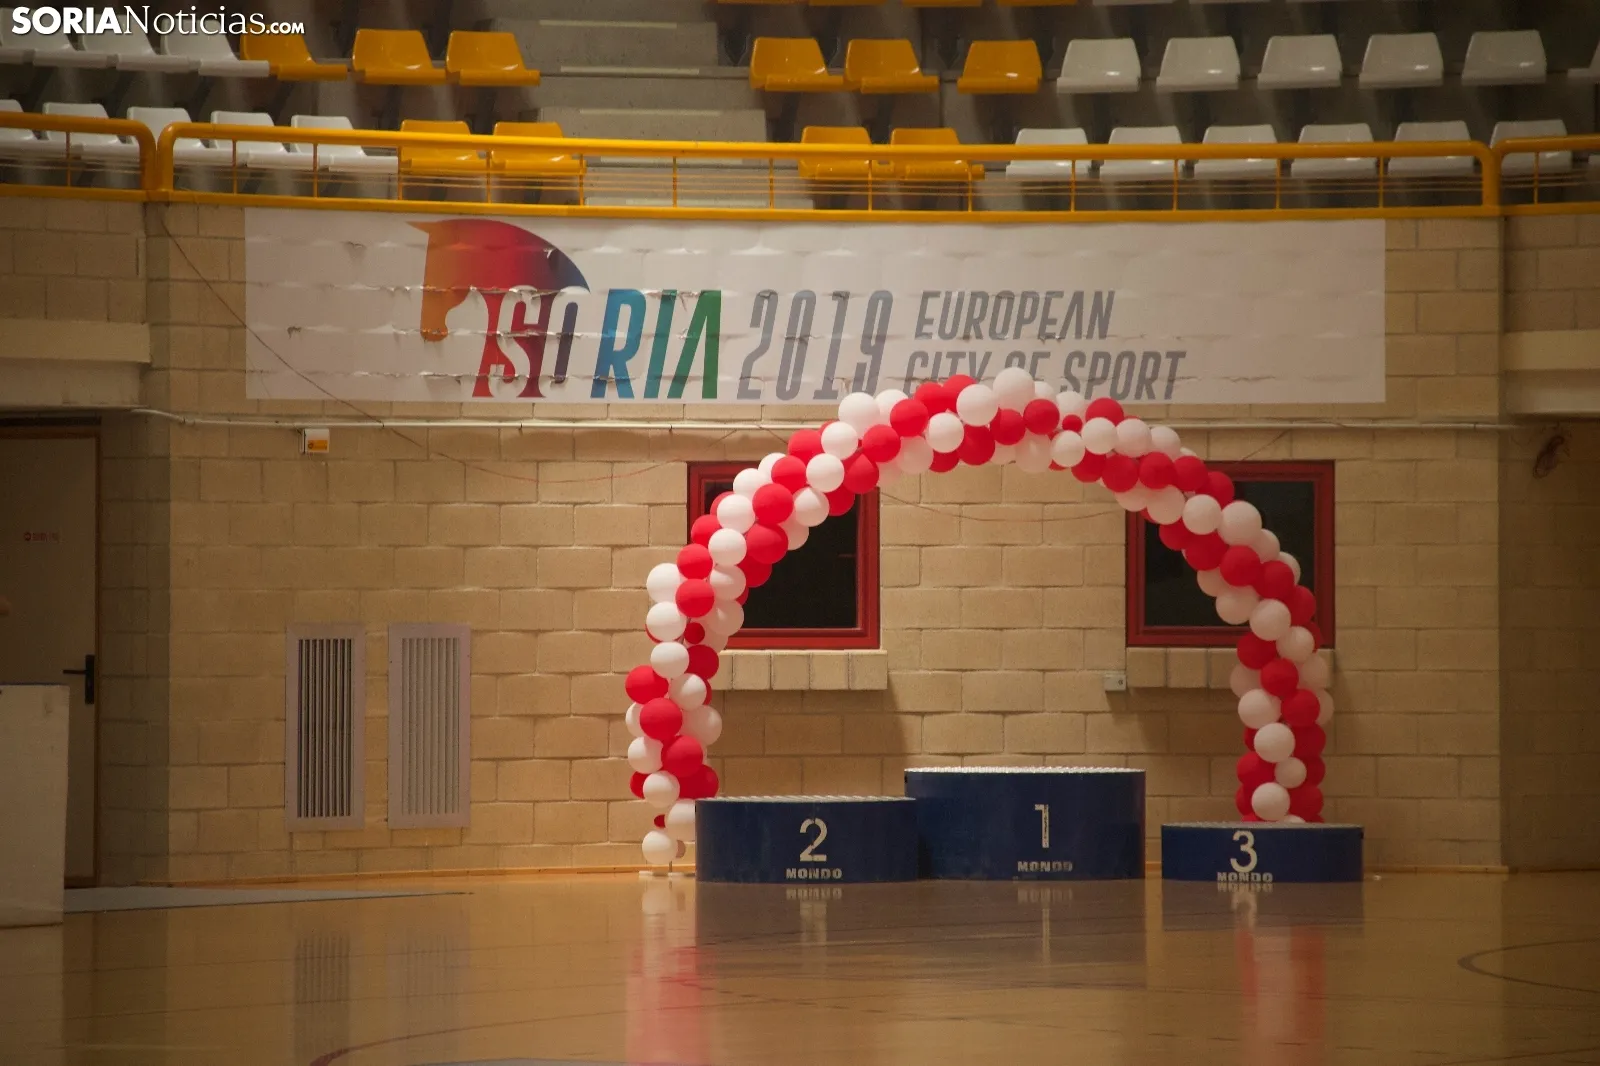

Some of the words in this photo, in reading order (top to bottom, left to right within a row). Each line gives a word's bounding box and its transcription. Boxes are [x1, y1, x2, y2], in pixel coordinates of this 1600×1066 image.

[914, 290, 1116, 341] EUROPEAN
[737, 289, 893, 401] 2019
[1060, 350, 1187, 401] SPORT
[800, 818, 828, 862] 2
[1034, 803, 1049, 848] 1
[786, 868, 843, 879] MONDO
[1017, 861, 1073, 872] MONDO
[1230, 830, 1258, 873] 3
[1217, 872, 1273, 882] MONDO
